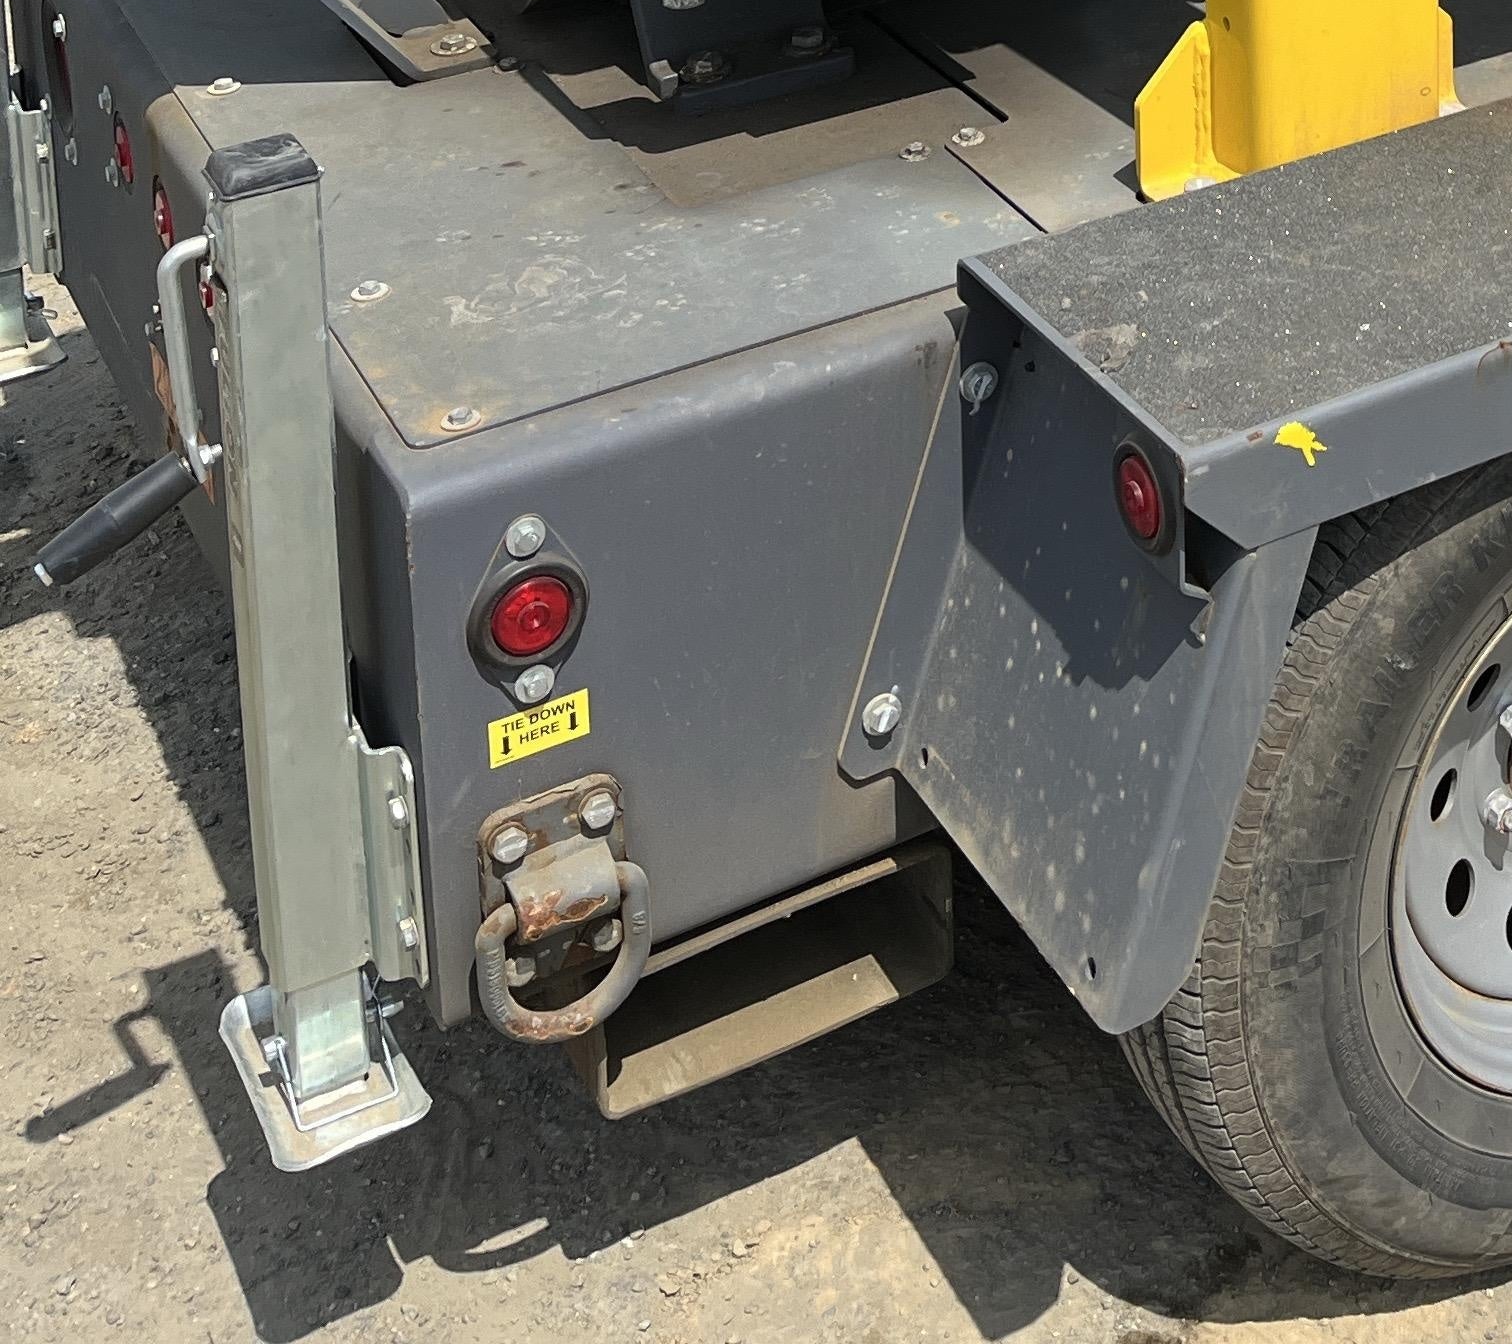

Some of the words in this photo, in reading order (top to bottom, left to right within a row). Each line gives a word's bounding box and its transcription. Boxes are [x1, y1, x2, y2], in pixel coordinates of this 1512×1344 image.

[501, 718, 526, 735] TIE
[528, 699, 576, 725] DOWN
[519, 720, 561, 745] HERE
